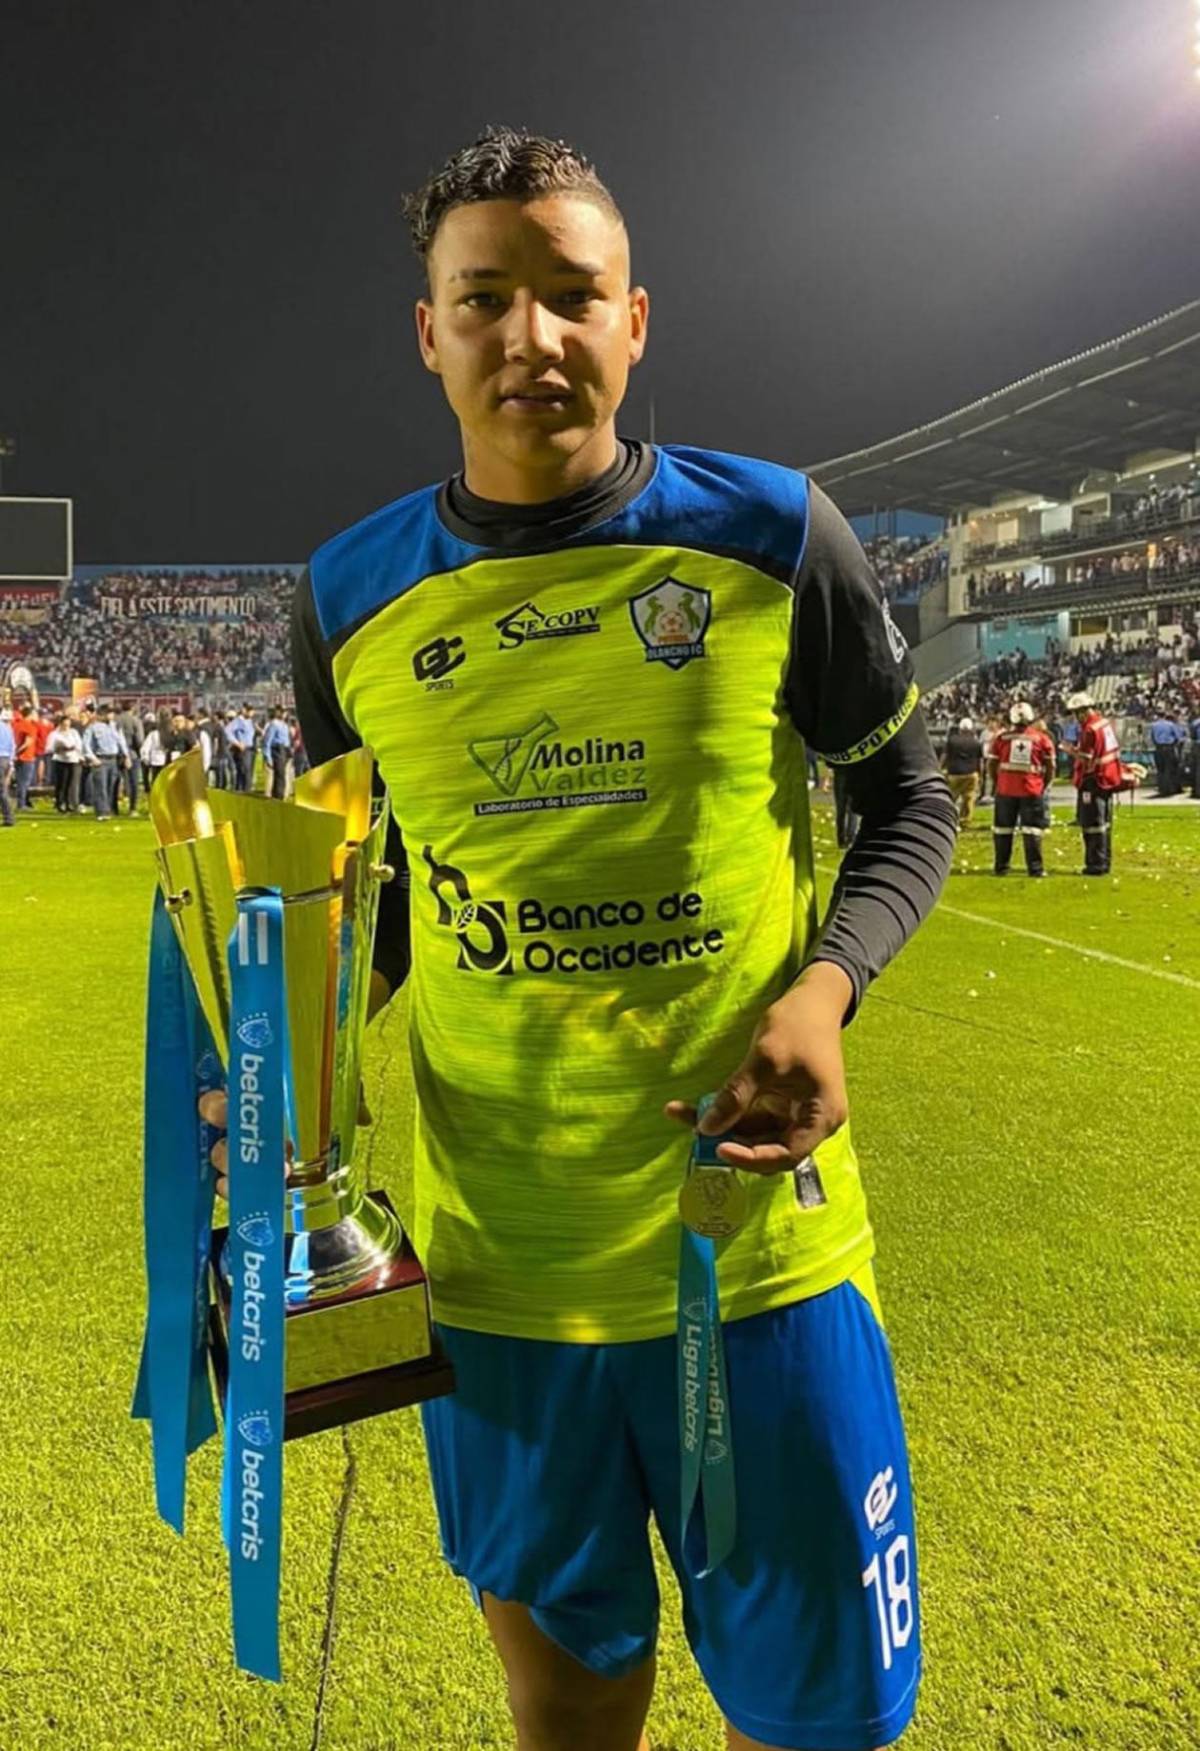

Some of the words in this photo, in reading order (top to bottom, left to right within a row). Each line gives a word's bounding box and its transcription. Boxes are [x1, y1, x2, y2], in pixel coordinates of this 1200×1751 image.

[140, 595, 173, 615] ESTE
[530, 737, 645, 770] Molina
[529, 765, 648, 792] Valdez
[477, 799, 543, 814] Laboratorio
[545, 797, 560, 807] de
[562, 790, 644, 806] Especialidades
[519, 899, 645, 934] Banco
[656, 892, 704, 922] de
[523, 928, 725, 974] Occidente
[240, 1053, 265, 1164] betcris
[242, 1251, 267, 1362] betcris
[241, 1449, 265, 1562] betcris
[861, 1534, 914, 1670] 18
